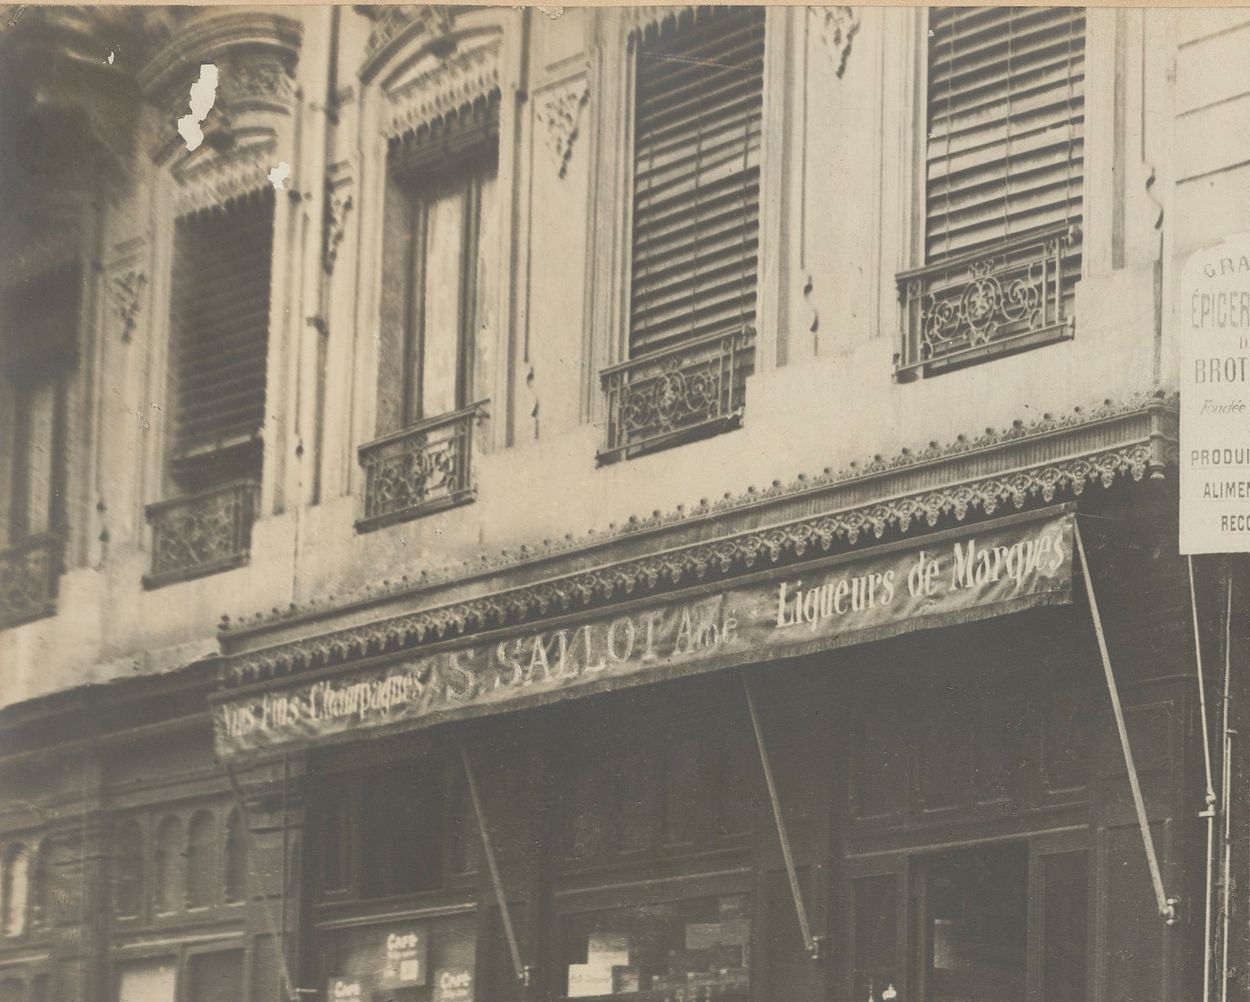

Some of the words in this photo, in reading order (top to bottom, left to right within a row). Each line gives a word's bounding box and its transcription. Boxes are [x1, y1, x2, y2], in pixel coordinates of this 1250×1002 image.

[1200, 399, 1246, 416] Fondée
[494, 607, 666, 688] SALLOT
[775, 568, 896, 630] Liqueurs
[908, 550, 940, 599] de
[950, 529, 1066, 591] Marques
